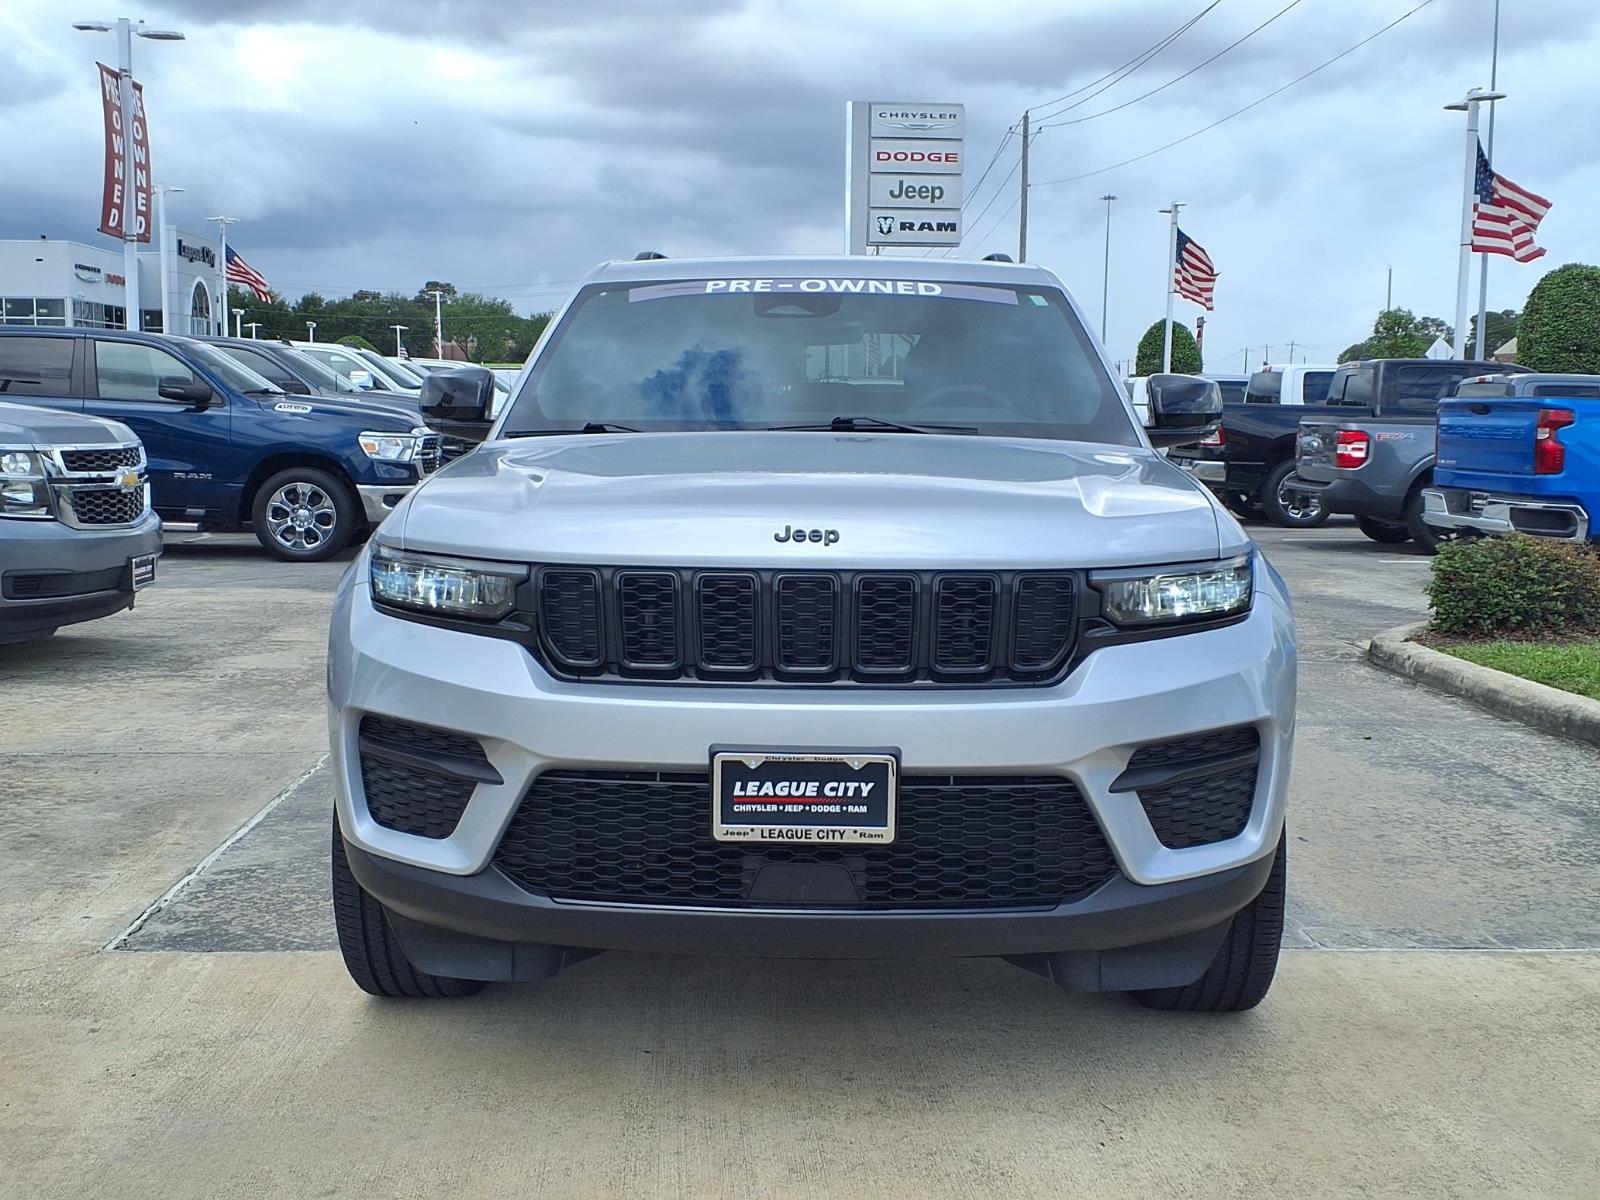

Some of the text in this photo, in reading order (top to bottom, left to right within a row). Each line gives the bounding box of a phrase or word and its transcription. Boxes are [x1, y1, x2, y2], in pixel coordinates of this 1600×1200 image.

[876, 151, 958, 163] DODGE
[108, 110, 123, 228] OWNED
[133, 121, 147, 234] OWNED
[889, 180, 944, 203] Jeep
[899, 221, 957, 232] RAM
[774, 525, 840, 547] Jeep
[733, 781, 875, 797] LEAGUE CITY
[733, 804, 778, 812] CHRYSLER
[784, 804, 804, 812] JEEP
[848, 805, 867, 813] RAM
[722, 829, 884, 840] Jeep LEAGUE CITY Ram
